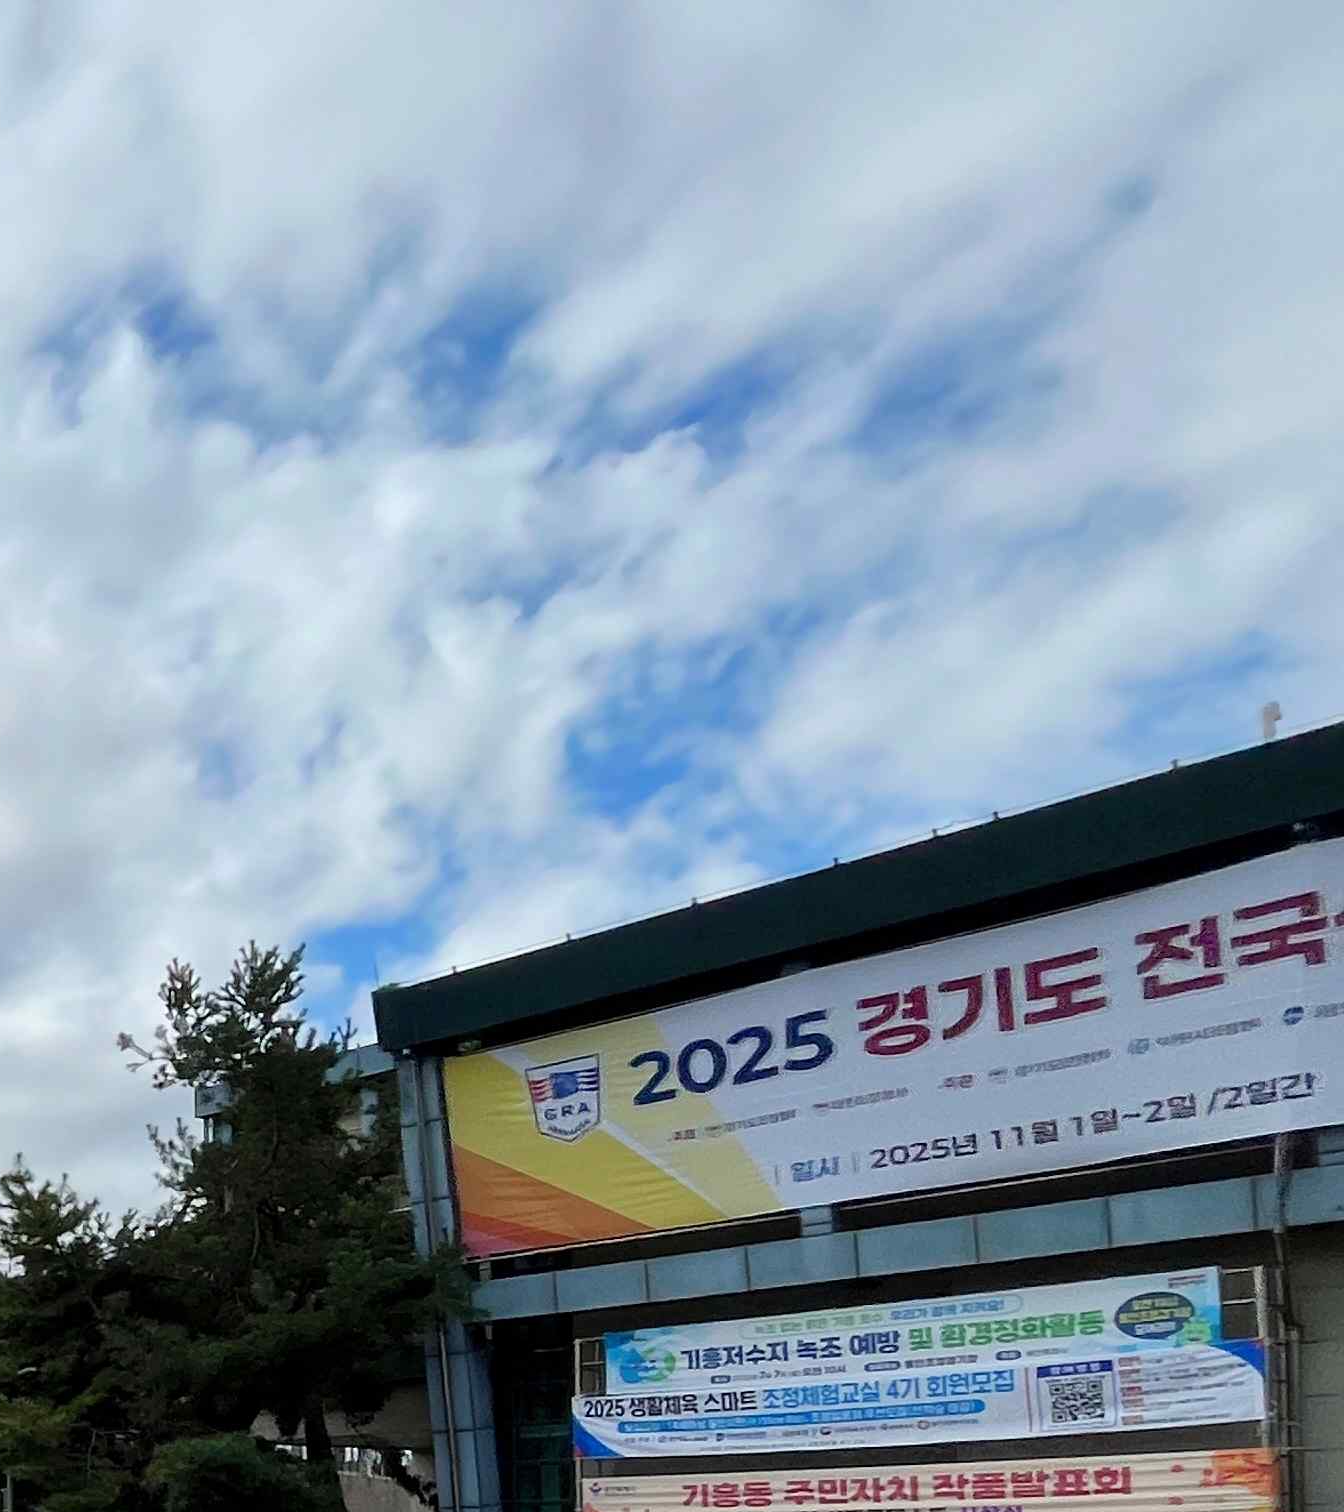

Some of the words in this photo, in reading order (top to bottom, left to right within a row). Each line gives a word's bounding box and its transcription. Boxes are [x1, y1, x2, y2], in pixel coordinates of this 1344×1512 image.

[628, 1008, 836, 1106] 2025
[855, 946, 1108, 1056] 경기도
[1135, 890, 1344, 1000] 전국
[543, 1102, 591, 1121] GRA
[869, 1132, 978, 1170] 2025년
[991, 1118, 1060, 1151] 11월
[681, 1342, 789, 1371] 기흥저수지
[796, 1336, 843, 1359] 녹조
[850, 1330, 901, 1356] 예방
[908, 1327, 932, 1351] 및
[941, 1310, 1106, 1349] 환경정화활동
[584, 1400, 625, 1418] 2025
[629, 1396, 699, 1418] 생활체육
[704, 1391, 758, 1413] 스마트
[762, 1379, 881, 1409] 조정체험교실
[886, 1376, 920, 1401] 4기
[927, 1369, 1015, 1400] 회원모집
[681, 1482, 774, 1508] 기흥동
[783, 1476, 919, 1505] 주민자치
[932, 1465, 1133, 1500] 작품발표회
